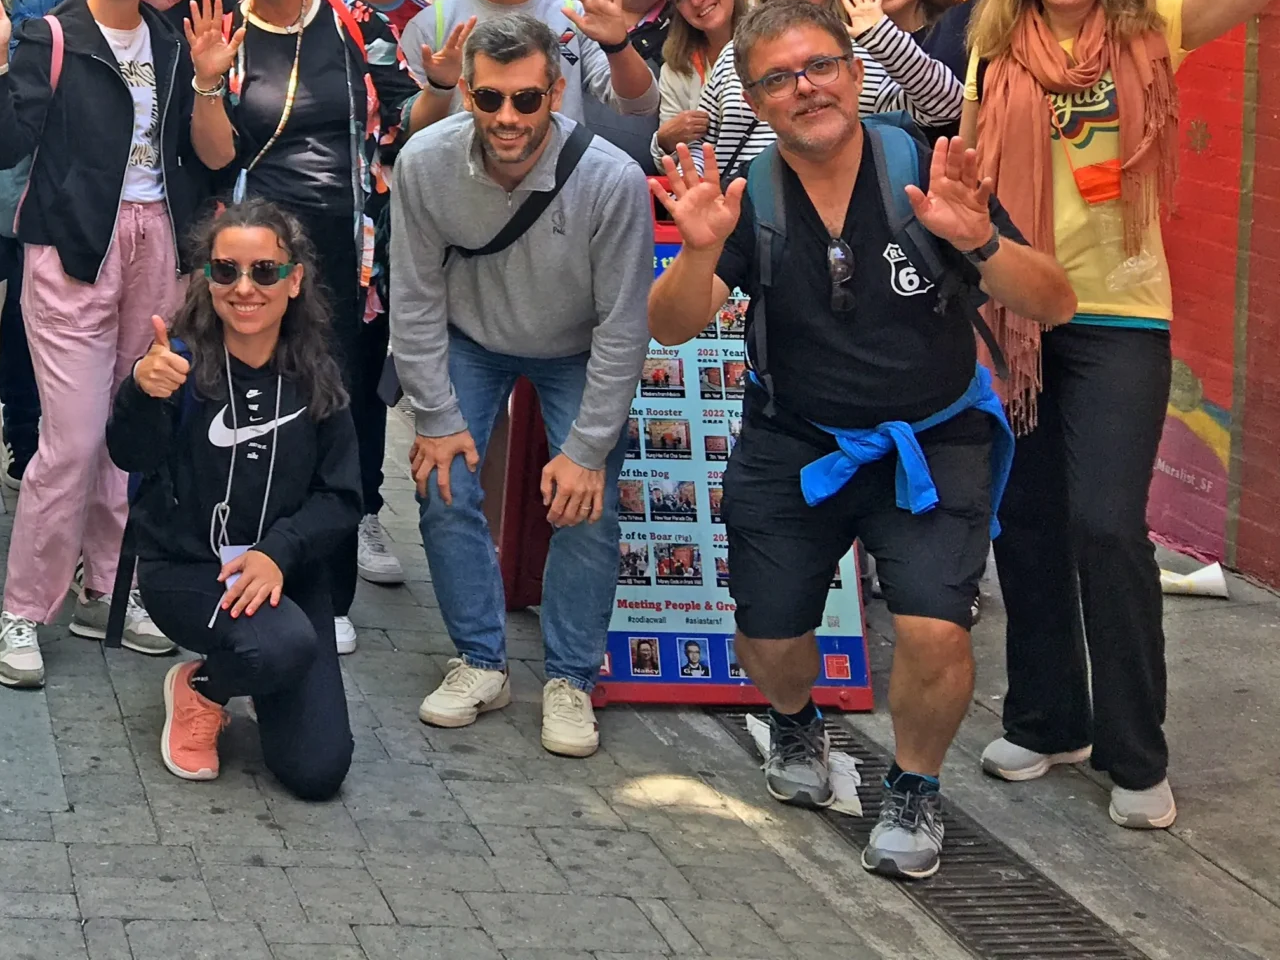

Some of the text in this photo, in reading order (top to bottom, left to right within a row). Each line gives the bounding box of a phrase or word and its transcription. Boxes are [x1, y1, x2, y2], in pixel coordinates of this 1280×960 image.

[697, 348, 719, 357] 2021
[646, 407, 683, 417] Rooster
[702, 409, 725, 418] 2022
[621, 469, 670, 480] of the Dog
[707, 471, 725, 479] 202
[625, 532, 636, 540] of
[649, 532, 673, 541] Boar
[712, 534, 729, 542] 202
[617, 599, 736, 612] Meeting People & Gre
[627, 615, 667, 624] #zodiacwall
[633, 667, 659, 675] Nancy
